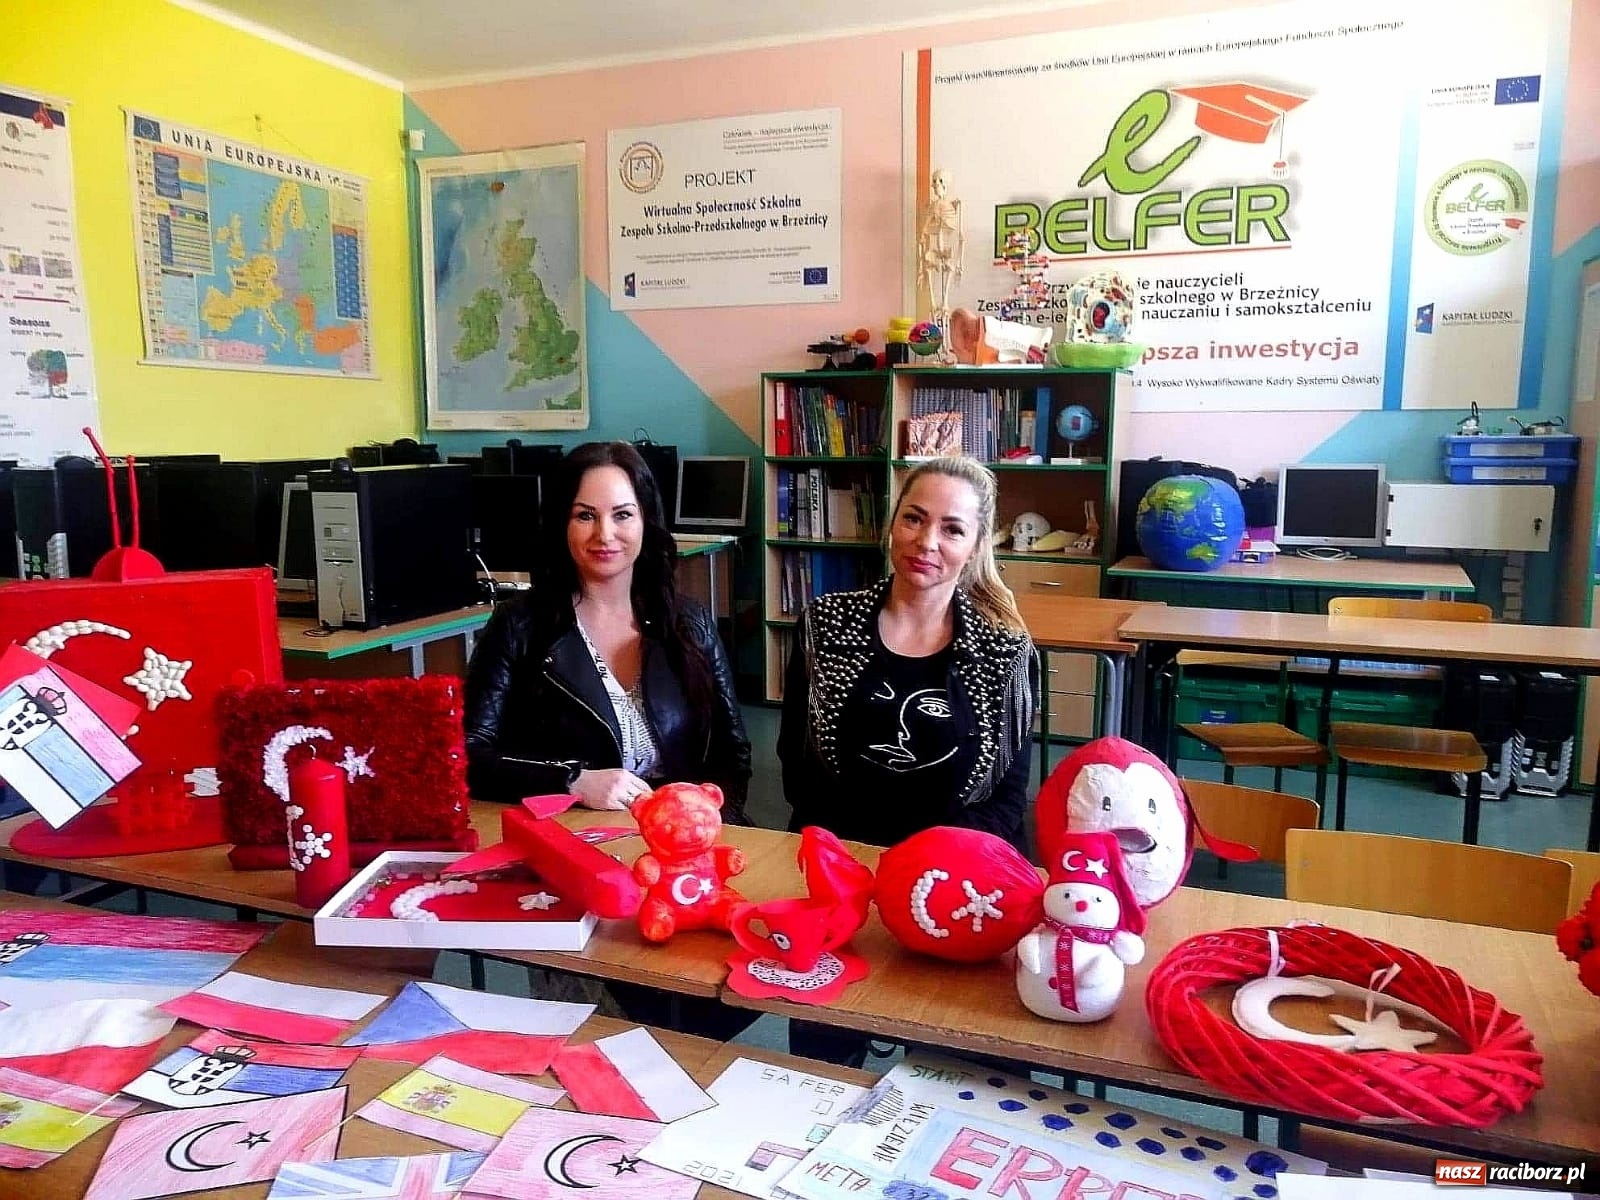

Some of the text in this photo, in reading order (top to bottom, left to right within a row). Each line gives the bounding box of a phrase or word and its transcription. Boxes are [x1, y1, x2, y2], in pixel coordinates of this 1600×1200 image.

[172, 130, 322, 183] UNIA EUROPEJSKA
[684, 168, 757, 189] PROJEKT
[644, 196, 801, 219] Wirtualna Społeczność Szkolna
[1445, 199, 1505, 214] BELFER
[657, 216, 767, 235] Szkolno-Przedszkolnego
[770, 219, 779, 228] w
[994, 182, 1290, 259] BELFER
[1155, 271, 1244, 292] nauczycieli
[1222, 292, 1234, 302] w
[1141, 306, 1220, 320] nauczaniu
[1225, 304, 1231, 317] i
[1235, 298, 1372, 318] samokształceniu
[1141, 337, 1360, 365] psza inwestycja
[909, 1064, 974, 1087] START
[682, 1160, 743, 1187] 2021
[805, 1161, 872, 1192] META
